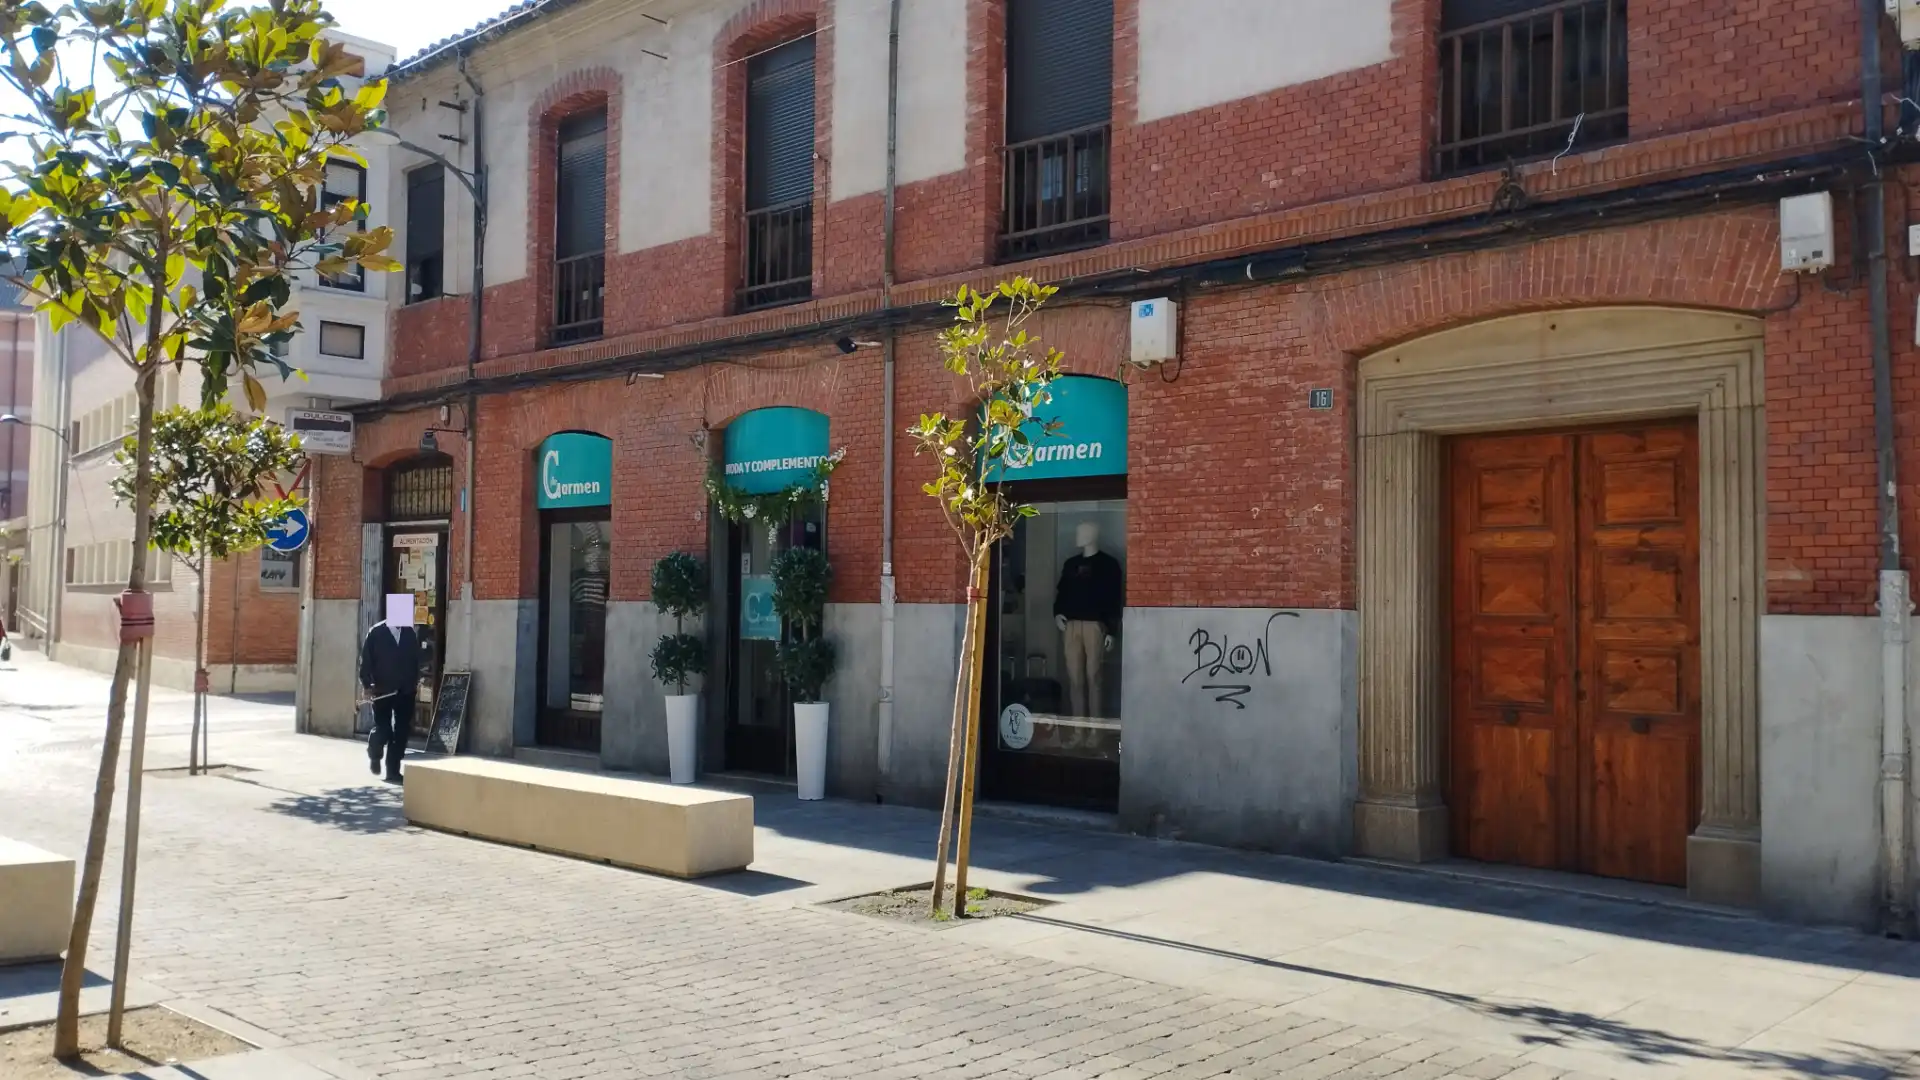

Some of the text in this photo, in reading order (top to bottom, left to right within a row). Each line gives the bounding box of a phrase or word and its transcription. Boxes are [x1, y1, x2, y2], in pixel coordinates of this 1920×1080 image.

[1316, 391, 1327, 407] 16
[303, 412, 343, 421] DULCES
[744, 461, 751, 473] Y
[543, 450, 600, 499] Carmen
